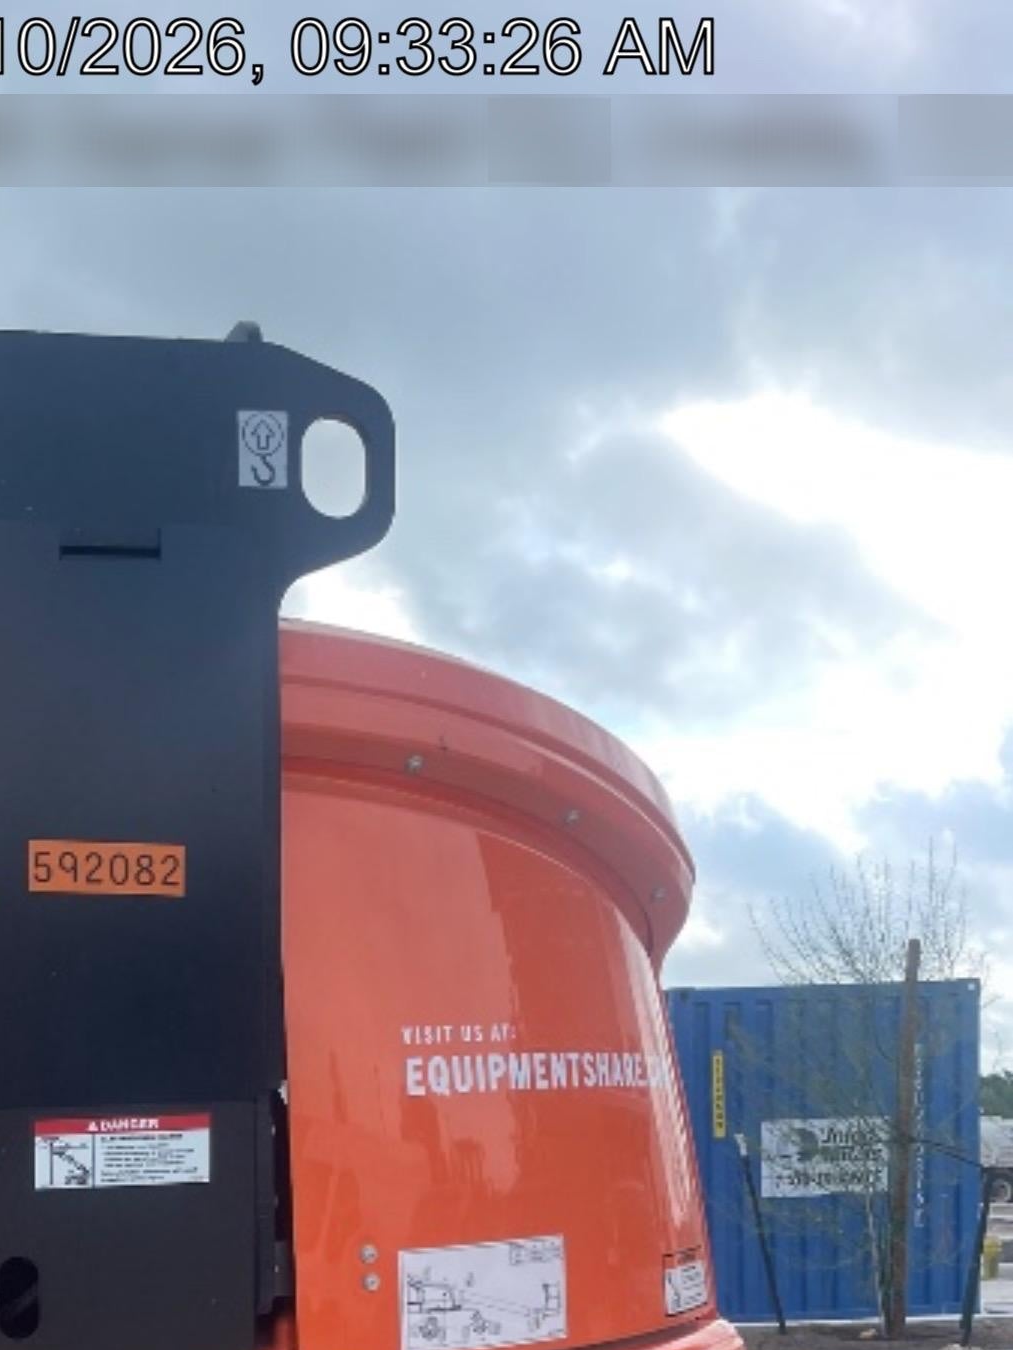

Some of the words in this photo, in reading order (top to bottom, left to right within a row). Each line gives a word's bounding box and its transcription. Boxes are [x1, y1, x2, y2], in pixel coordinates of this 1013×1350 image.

[33, 850, 181, 887] 592082
[401, 1025, 453, 1045] VISIT
[461, 1025, 483, 1043] US
